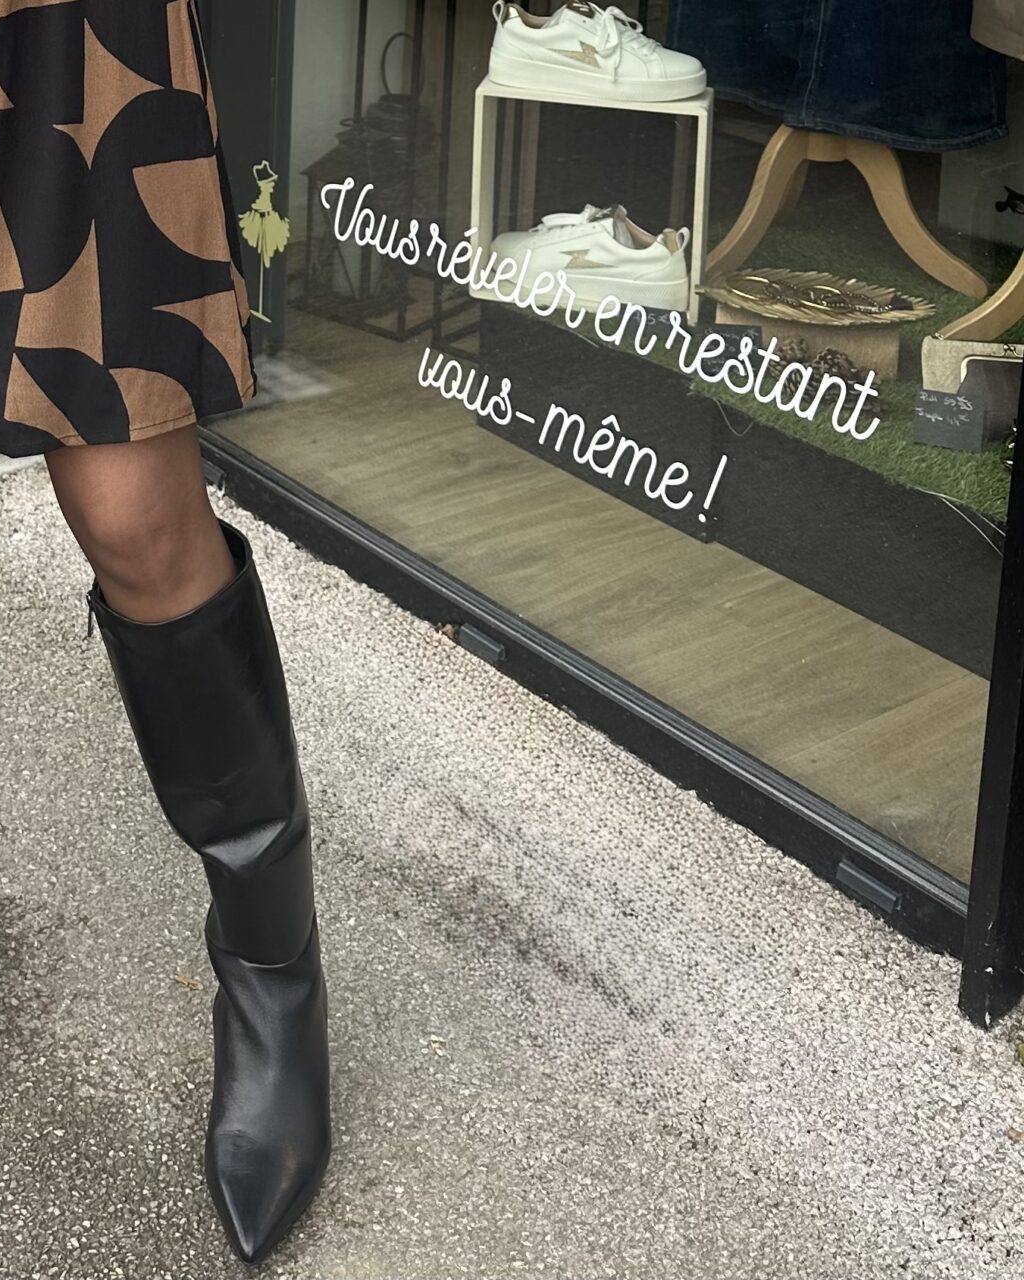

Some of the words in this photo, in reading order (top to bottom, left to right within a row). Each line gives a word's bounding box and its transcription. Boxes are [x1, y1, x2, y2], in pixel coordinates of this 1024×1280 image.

[320, 176, 421, 266] Vous
[425, 223, 586, 329] réveler
[594, 294, 658, 356] en
[664, 310, 881, 441] restant
[417, 346, 694, 510] vous-même
